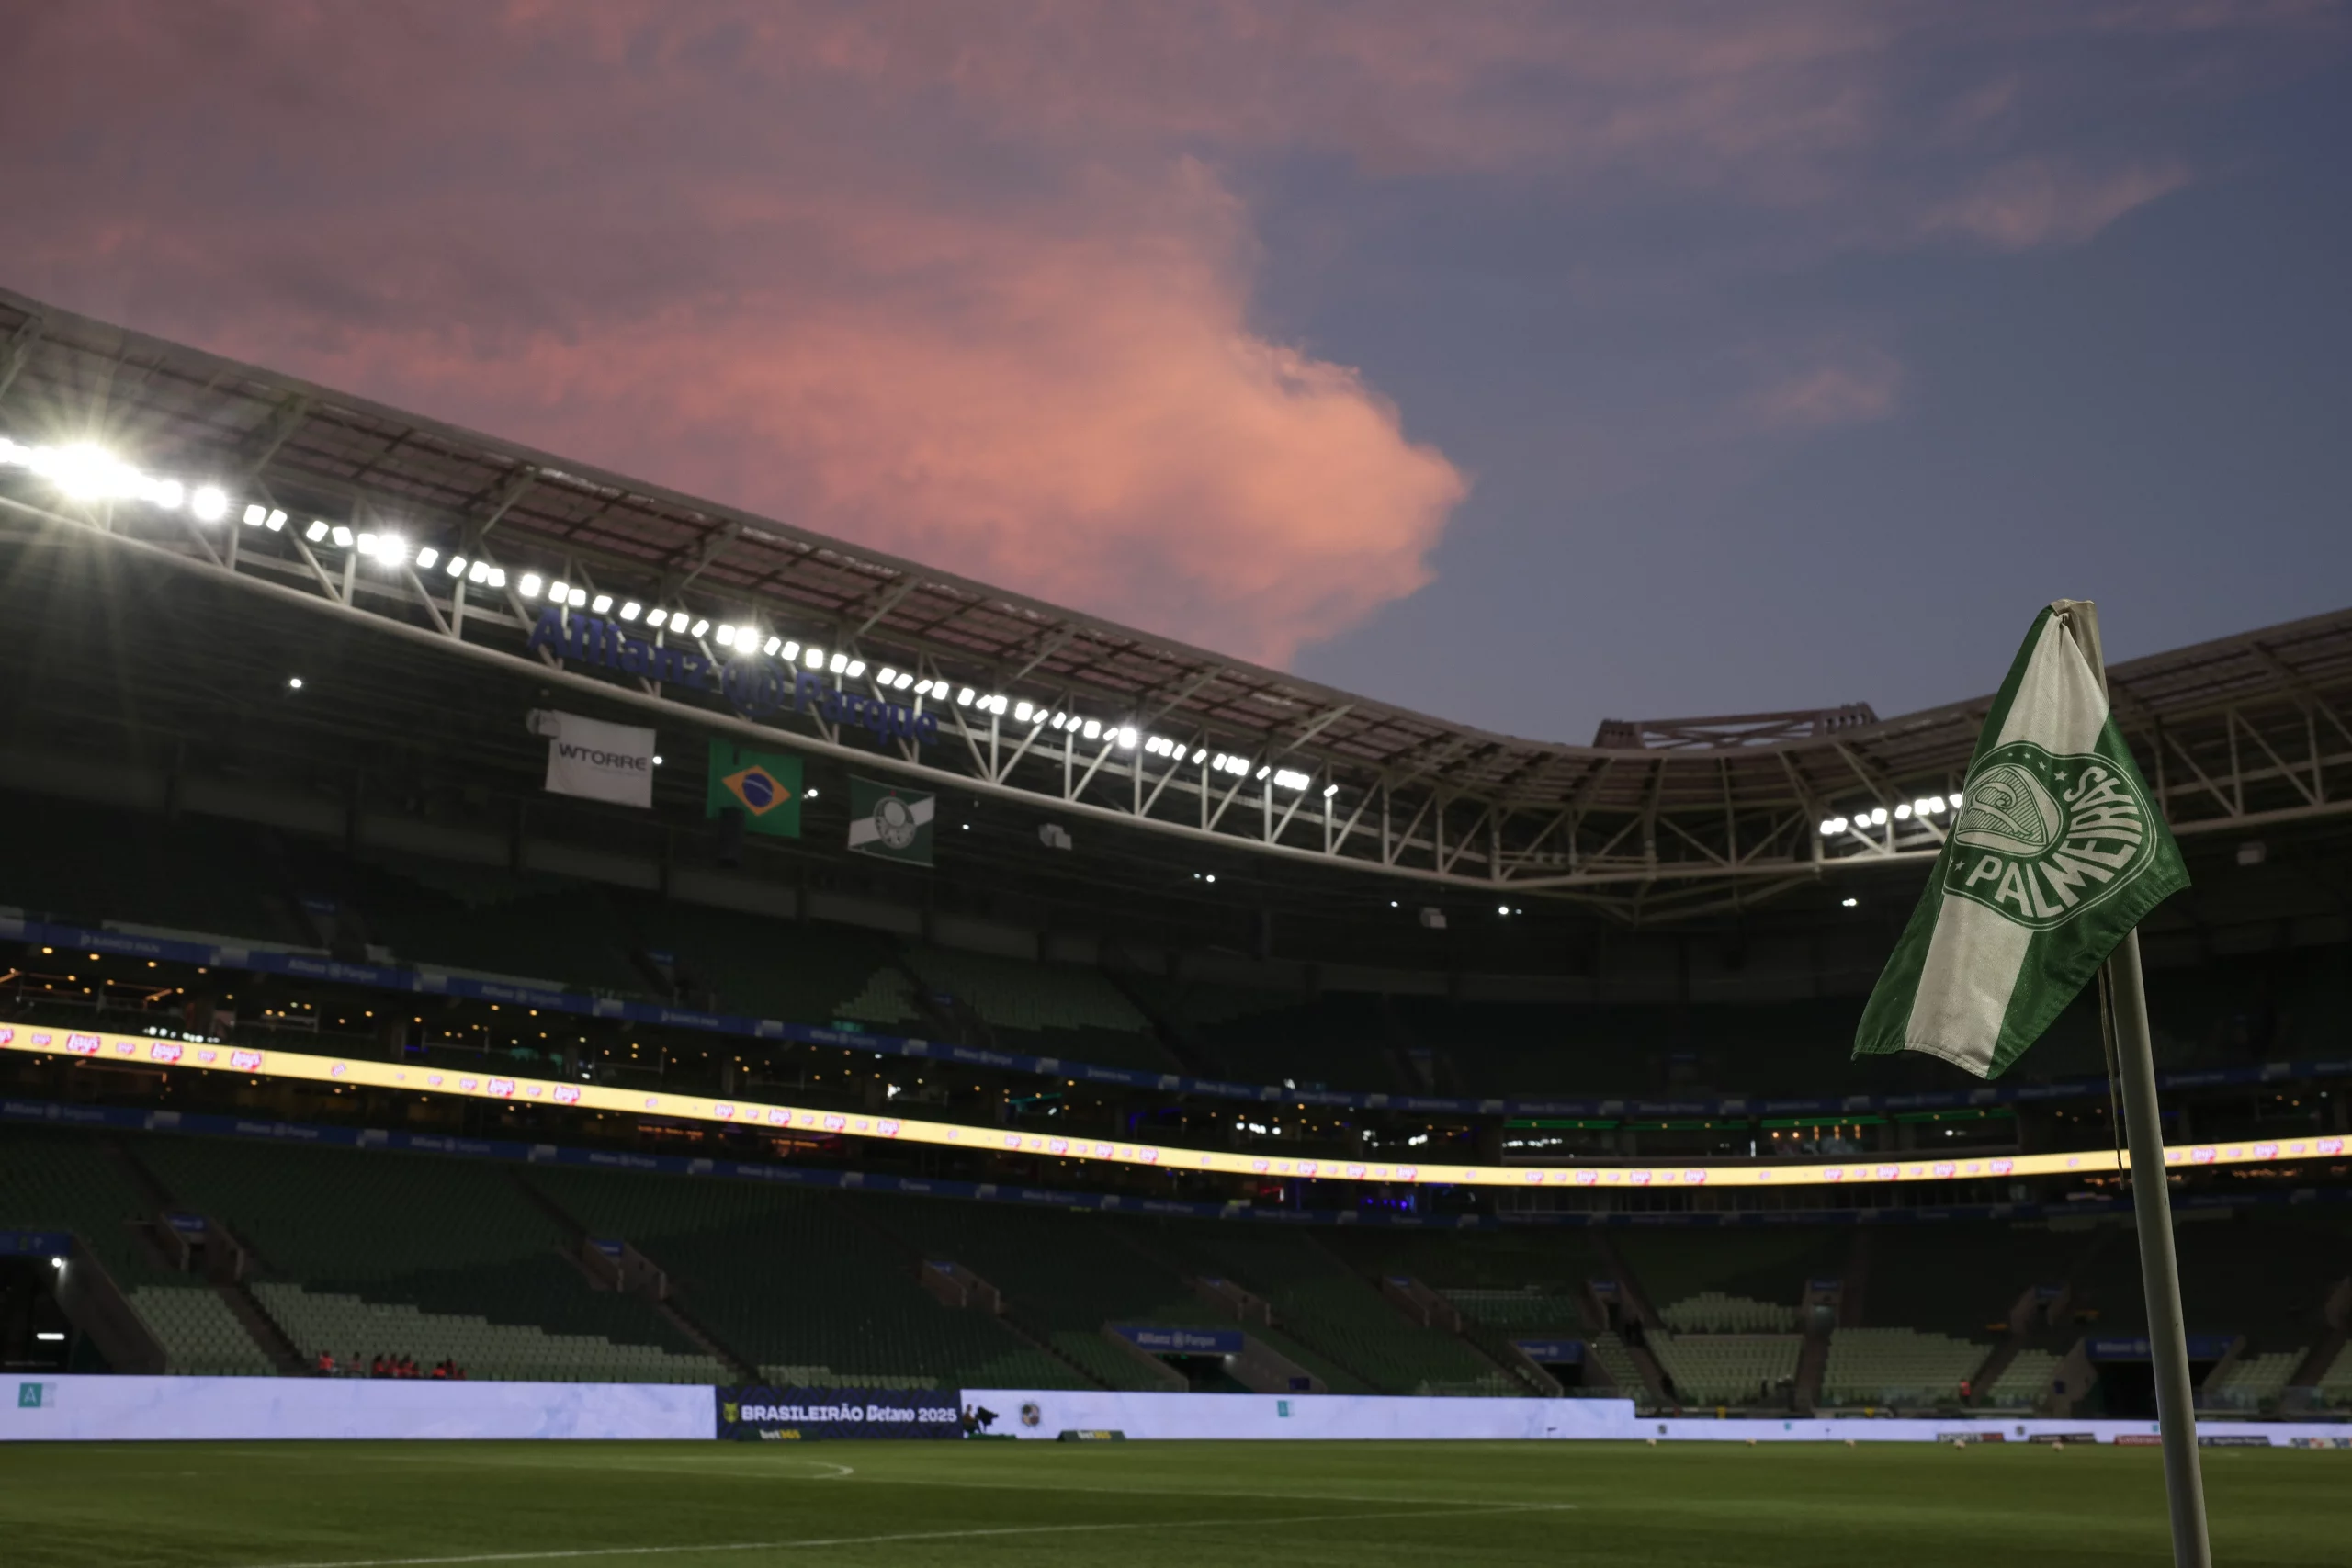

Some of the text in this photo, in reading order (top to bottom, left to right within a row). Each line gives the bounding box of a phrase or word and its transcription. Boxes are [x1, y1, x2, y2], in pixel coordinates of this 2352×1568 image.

[559, 742, 648, 771] WTORRE
[1965, 765, 2143, 919] PALMEIRAS
[741, 1403, 957, 1423] BRASILEIRÃO Betano 2025
[759, 1429, 801, 1440] bet365
